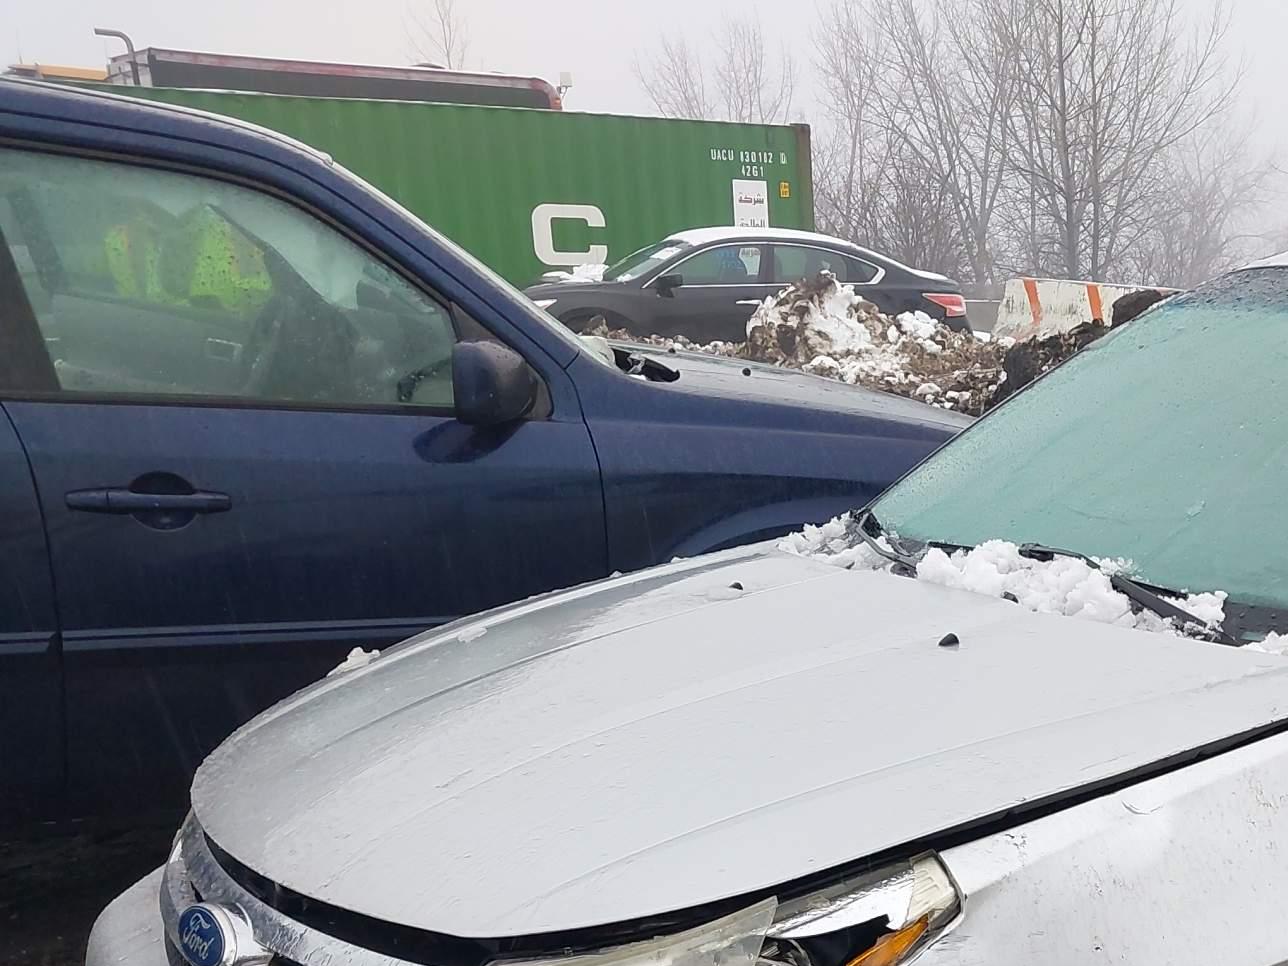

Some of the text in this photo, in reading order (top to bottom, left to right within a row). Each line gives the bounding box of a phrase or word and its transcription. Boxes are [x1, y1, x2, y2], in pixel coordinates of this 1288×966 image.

[710, 148, 734, 161] UACU
[741, 164, 764, 177] 42G1
[738, 192, 764, 205] شركة
[531, 203, 608, 266] C
[183, 912, 215, 960] Ford
